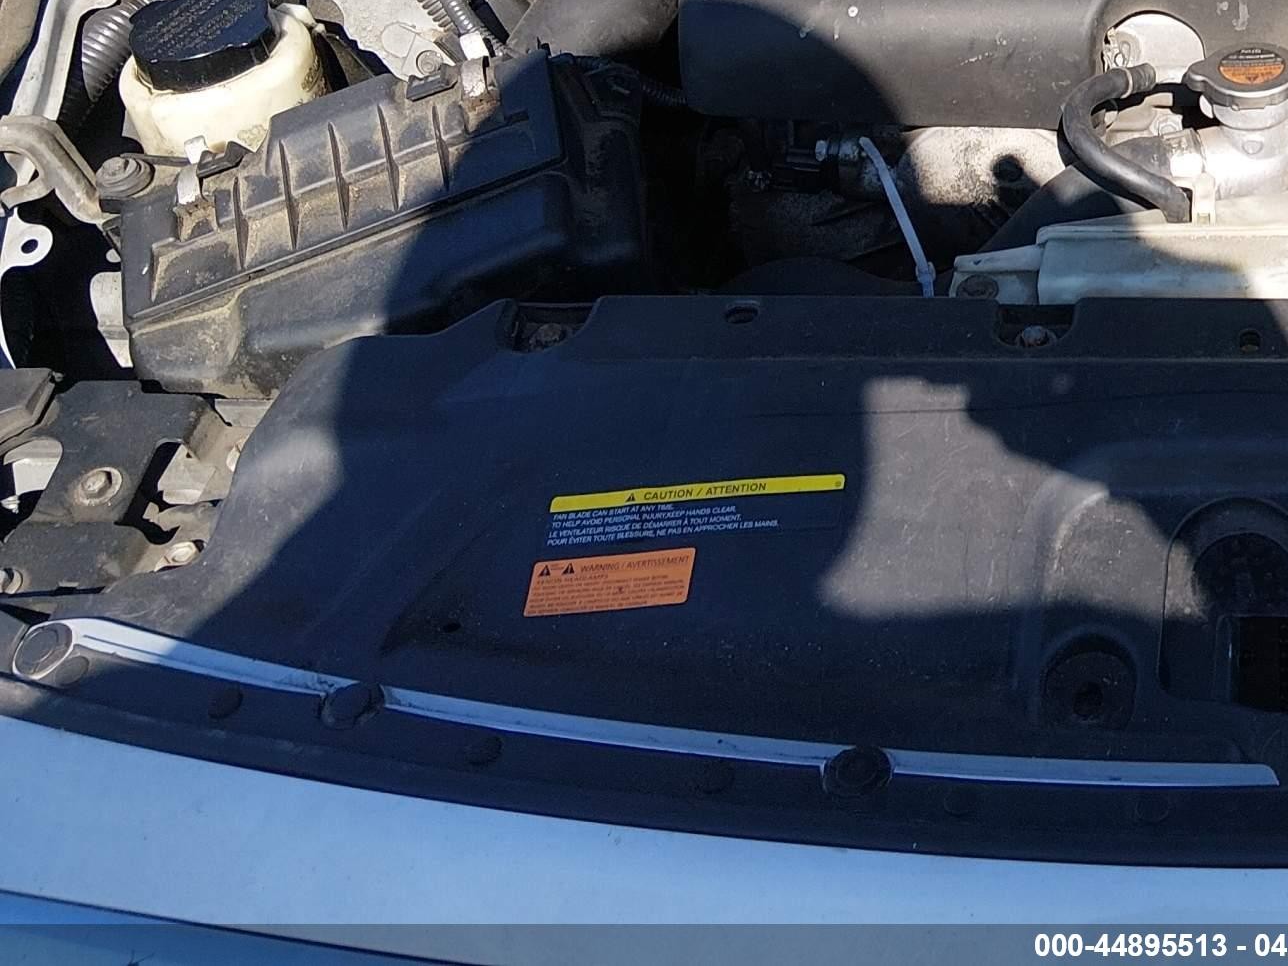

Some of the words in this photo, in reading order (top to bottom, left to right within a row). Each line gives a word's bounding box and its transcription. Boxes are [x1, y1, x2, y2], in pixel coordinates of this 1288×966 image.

[643, 488, 693, 501] CAUTION
[697, 487, 703, 495] /
[705, 483, 767, 495] ATTENTION
[552, 521, 561, 529] TO
[562, 520, 580, 528] HELP
[581, 518, 603, 526] AVOID
[604, 513, 640, 524] PERSONAL
[686, 507, 711, 516] HANDS
[553, 513, 567, 521] FAN
[568, 511, 591, 520] BLADE
[592, 509, 608, 517] CAN
[609, 507, 630, 516] START
[630, 505, 639, 513] AT
[546, 538, 568, 547] POUR
[593, 533, 616, 542] TOUTE
[656, 529, 667, 537] NE
[667, 527, 682, 536] PAS
[683, 526, 694, 534] EN
[694, 522, 739, 532] APPROCHER
[739, 520, 753, 529] LES
[548, 531, 557, 539] LE
[559, 526, 603, 537] VENTILATEUR
[605, 523, 631, 533] RISQUE
[631, 522, 642, 530] DE
[690, 517, 708, 525] TOUT
[580, 561, 620, 573] WARNING
[626, 555, 690, 569] AVERTISSEMENT
